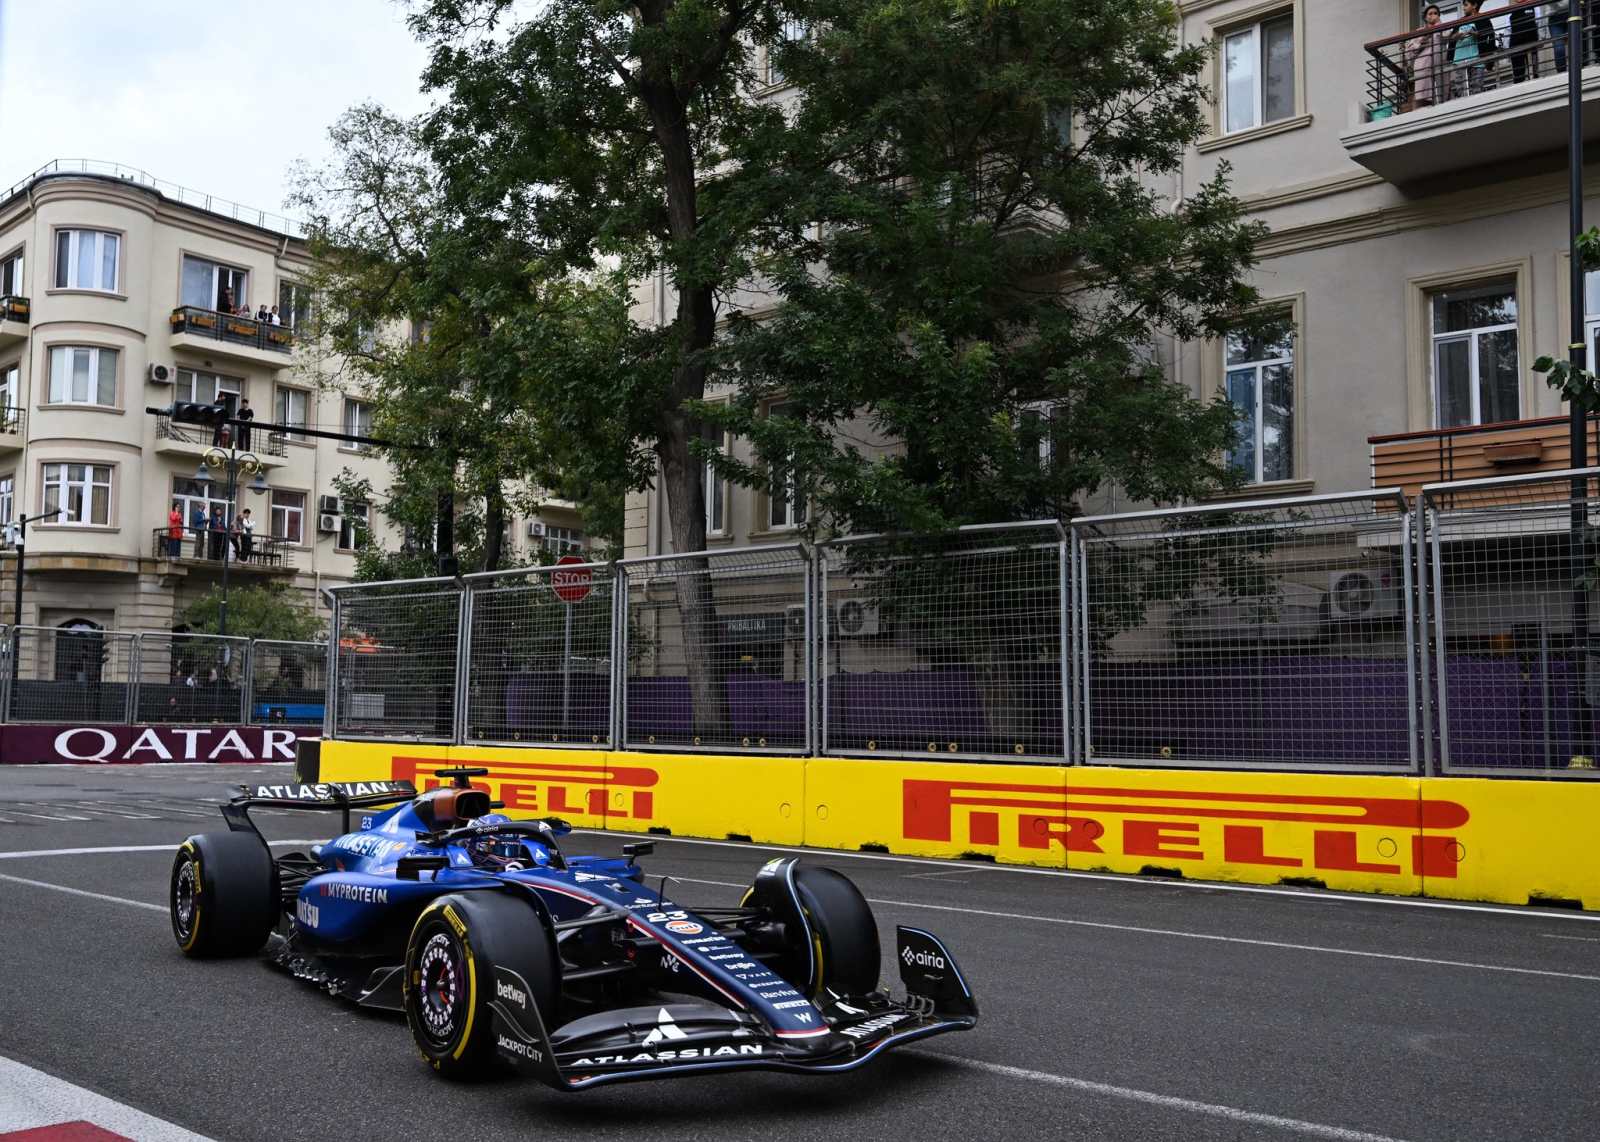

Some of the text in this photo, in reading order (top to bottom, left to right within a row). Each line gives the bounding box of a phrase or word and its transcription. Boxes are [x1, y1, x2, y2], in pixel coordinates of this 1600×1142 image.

[554, 571, 591, 585] STOP
[54, 727, 296, 763] QATAR
[361, 816, 373, 830] 23
[902, 778, 1470, 878] PIRELLI
[327, 882, 388, 904] MYPROTEIN
[646, 910, 689, 923] 23
[915, 950, 945, 970] airia
[496, 980, 527, 1009] betway
[497, 1033, 543, 1063] JACKPOT CITY
[571, 1044, 763, 1067] ATLASSIAN
